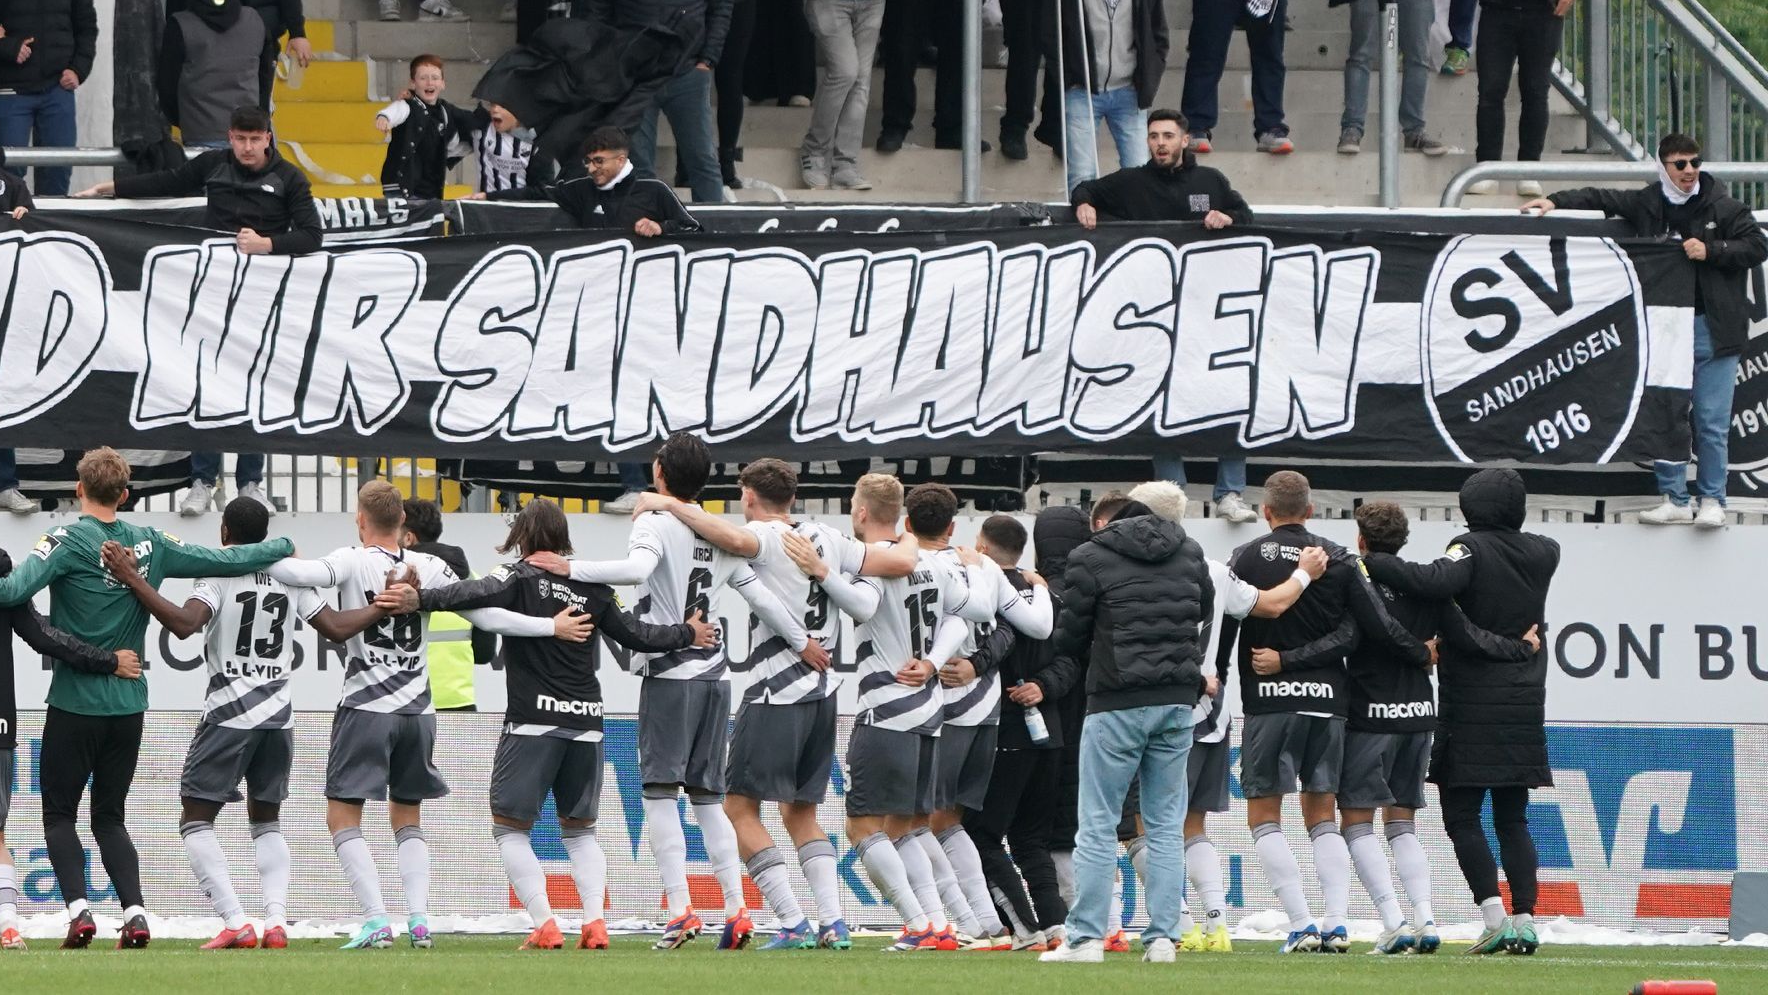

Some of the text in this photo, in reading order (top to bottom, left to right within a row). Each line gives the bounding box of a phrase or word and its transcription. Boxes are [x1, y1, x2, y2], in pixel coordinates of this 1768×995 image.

[1450, 235, 1573, 353] SV
[129, 240, 427, 435] WIR
[432, 236, 1382, 453] SANDHAUSEN
[1466, 323, 1622, 423] SANDHAUSEN
[1526, 402, 1592, 454] 1916
[235, 590, 289, 659] 13
[904, 588, 939, 661] 15
[1544, 622, 1665, 679] ON
[1259, 681, 1334, 699] macron
[1368, 700, 1434, 719] macron
